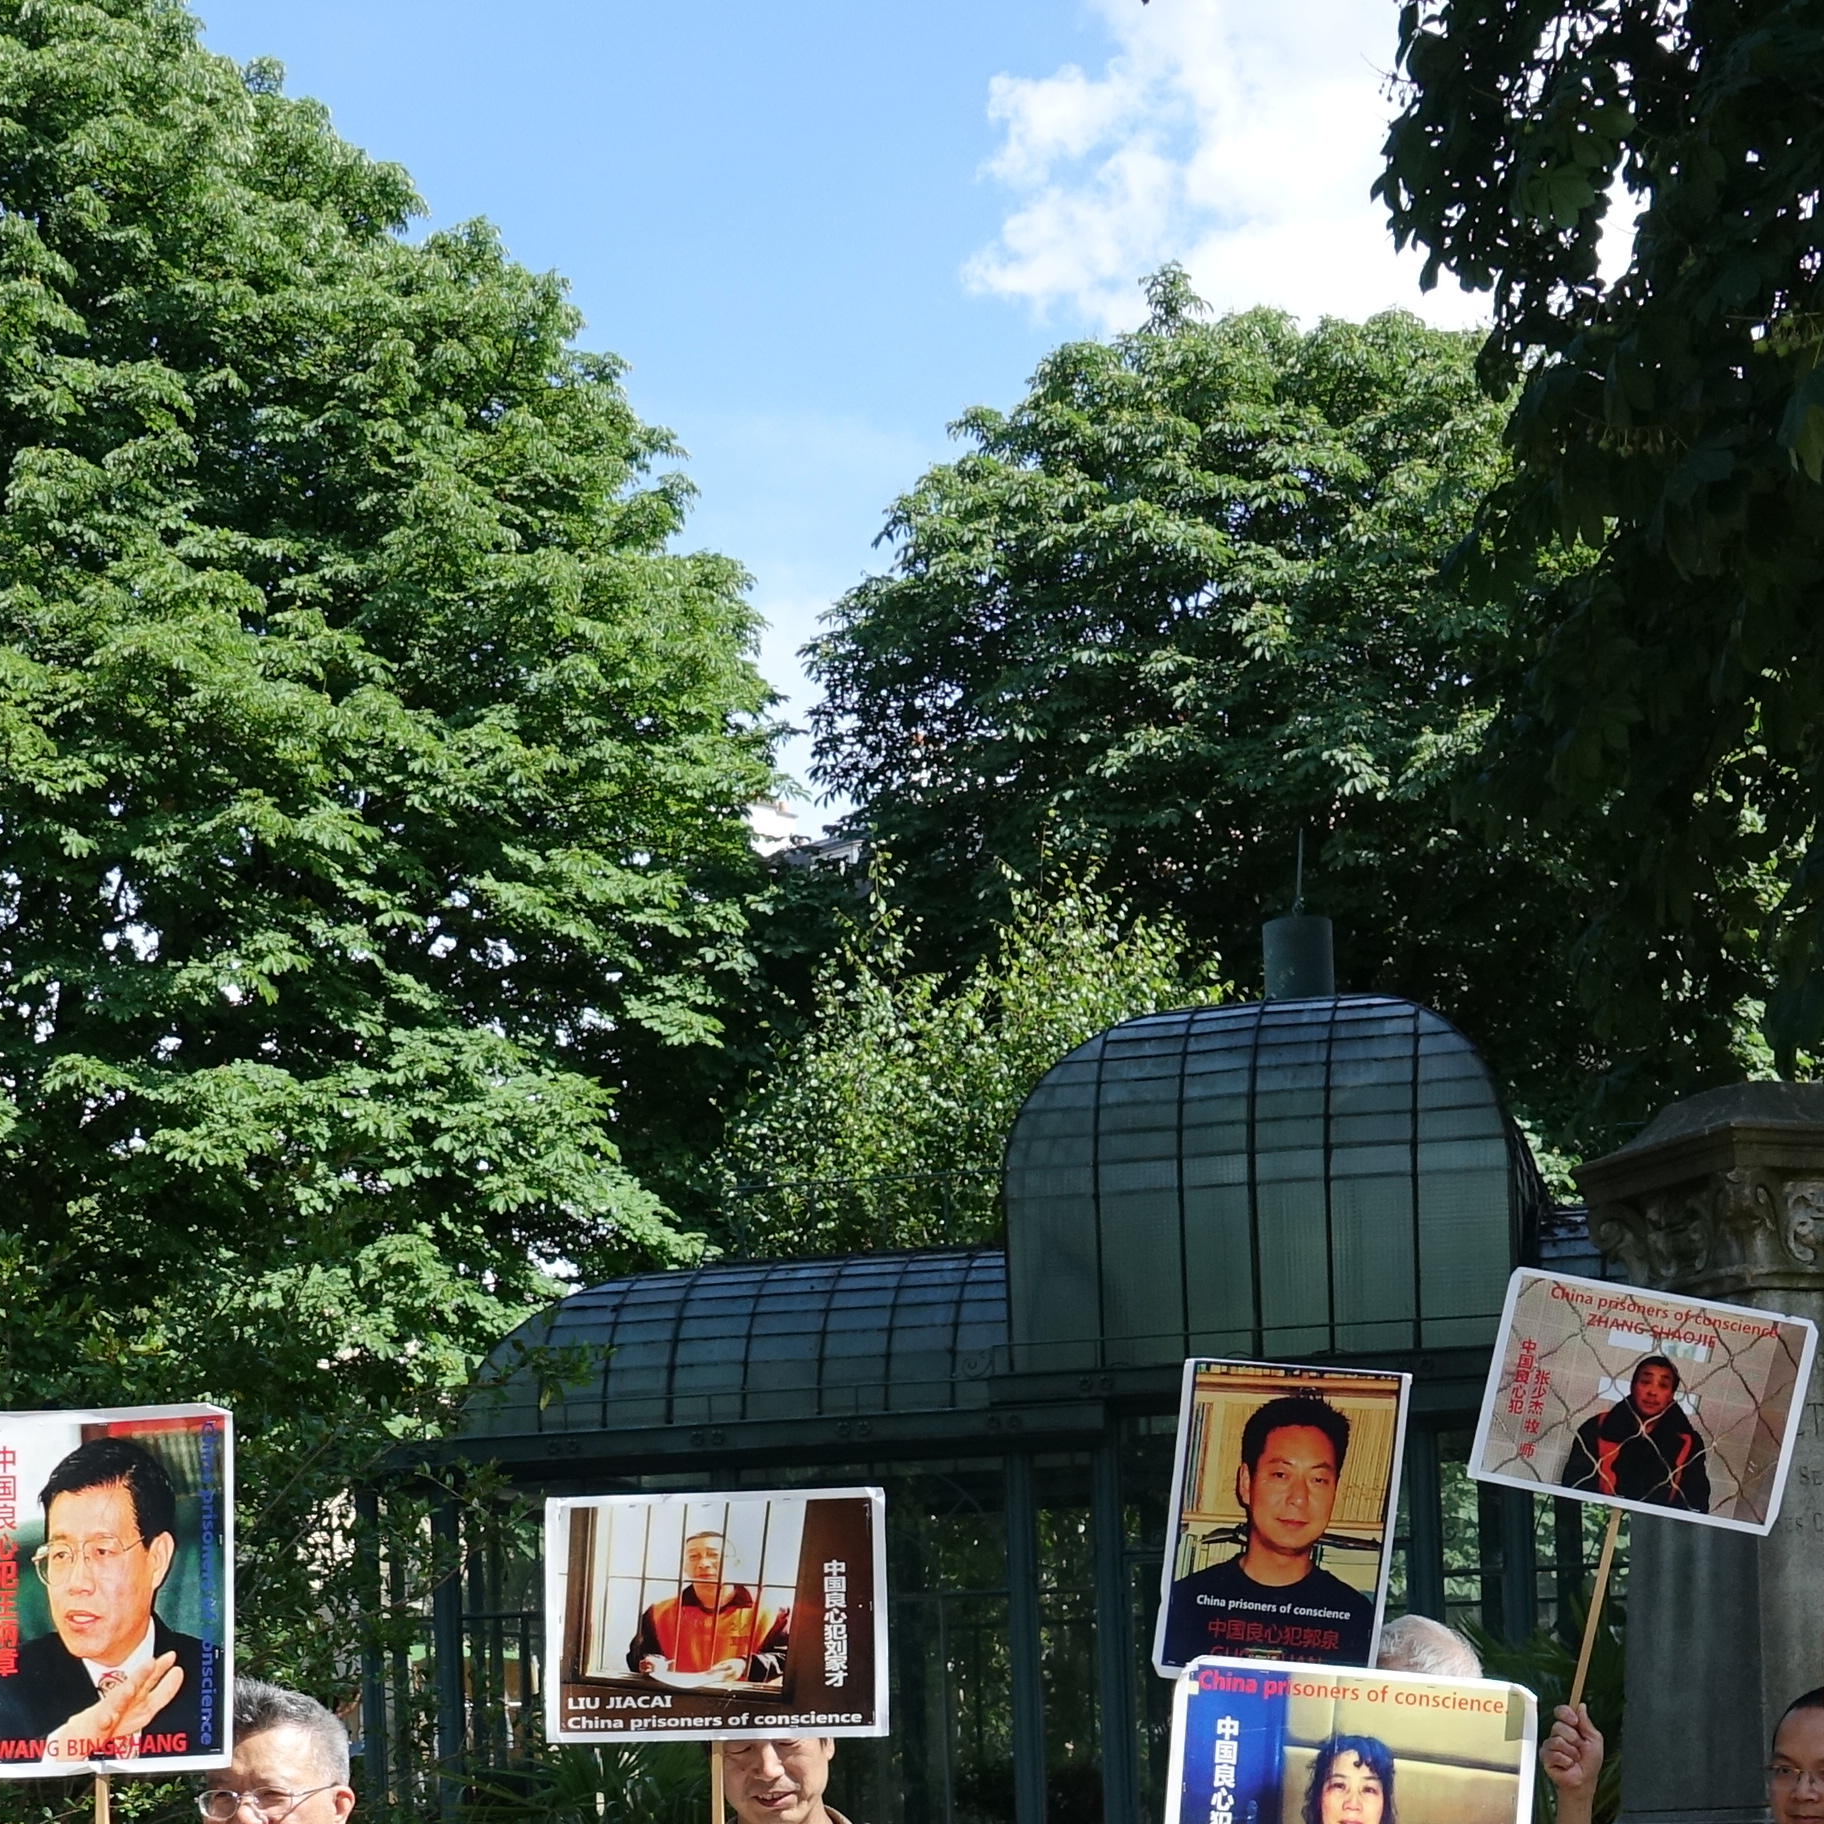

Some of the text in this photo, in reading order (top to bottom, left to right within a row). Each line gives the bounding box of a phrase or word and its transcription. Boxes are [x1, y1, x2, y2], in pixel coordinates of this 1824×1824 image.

[1550, 1285, 1778, 1339] China prisoners of conscience
[1586, 1313, 1717, 1349] ZHANG SHAOJIE
[1508, 1339, 1537, 1414] 中国良心犯
[199, 1489, 217, 1591] prisoners
[823, 1559, 848, 1688] 中国良心犯刘家才
[1196, 1594, 1351, 1620] China prisoners of conscience
[1208, 1618, 1339, 1650] 中国良心犯郭泉
[200, 1626, 217, 1746] conscience
[567, 1695, 672, 1710] LIU JIACAI
[1198, 1668, 1510, 1715] China prisoners of conscience.
[567, 1710, 863, 1732] China prisoners of conscience
[66, 1731, 187, 1758] BINGZHANG
